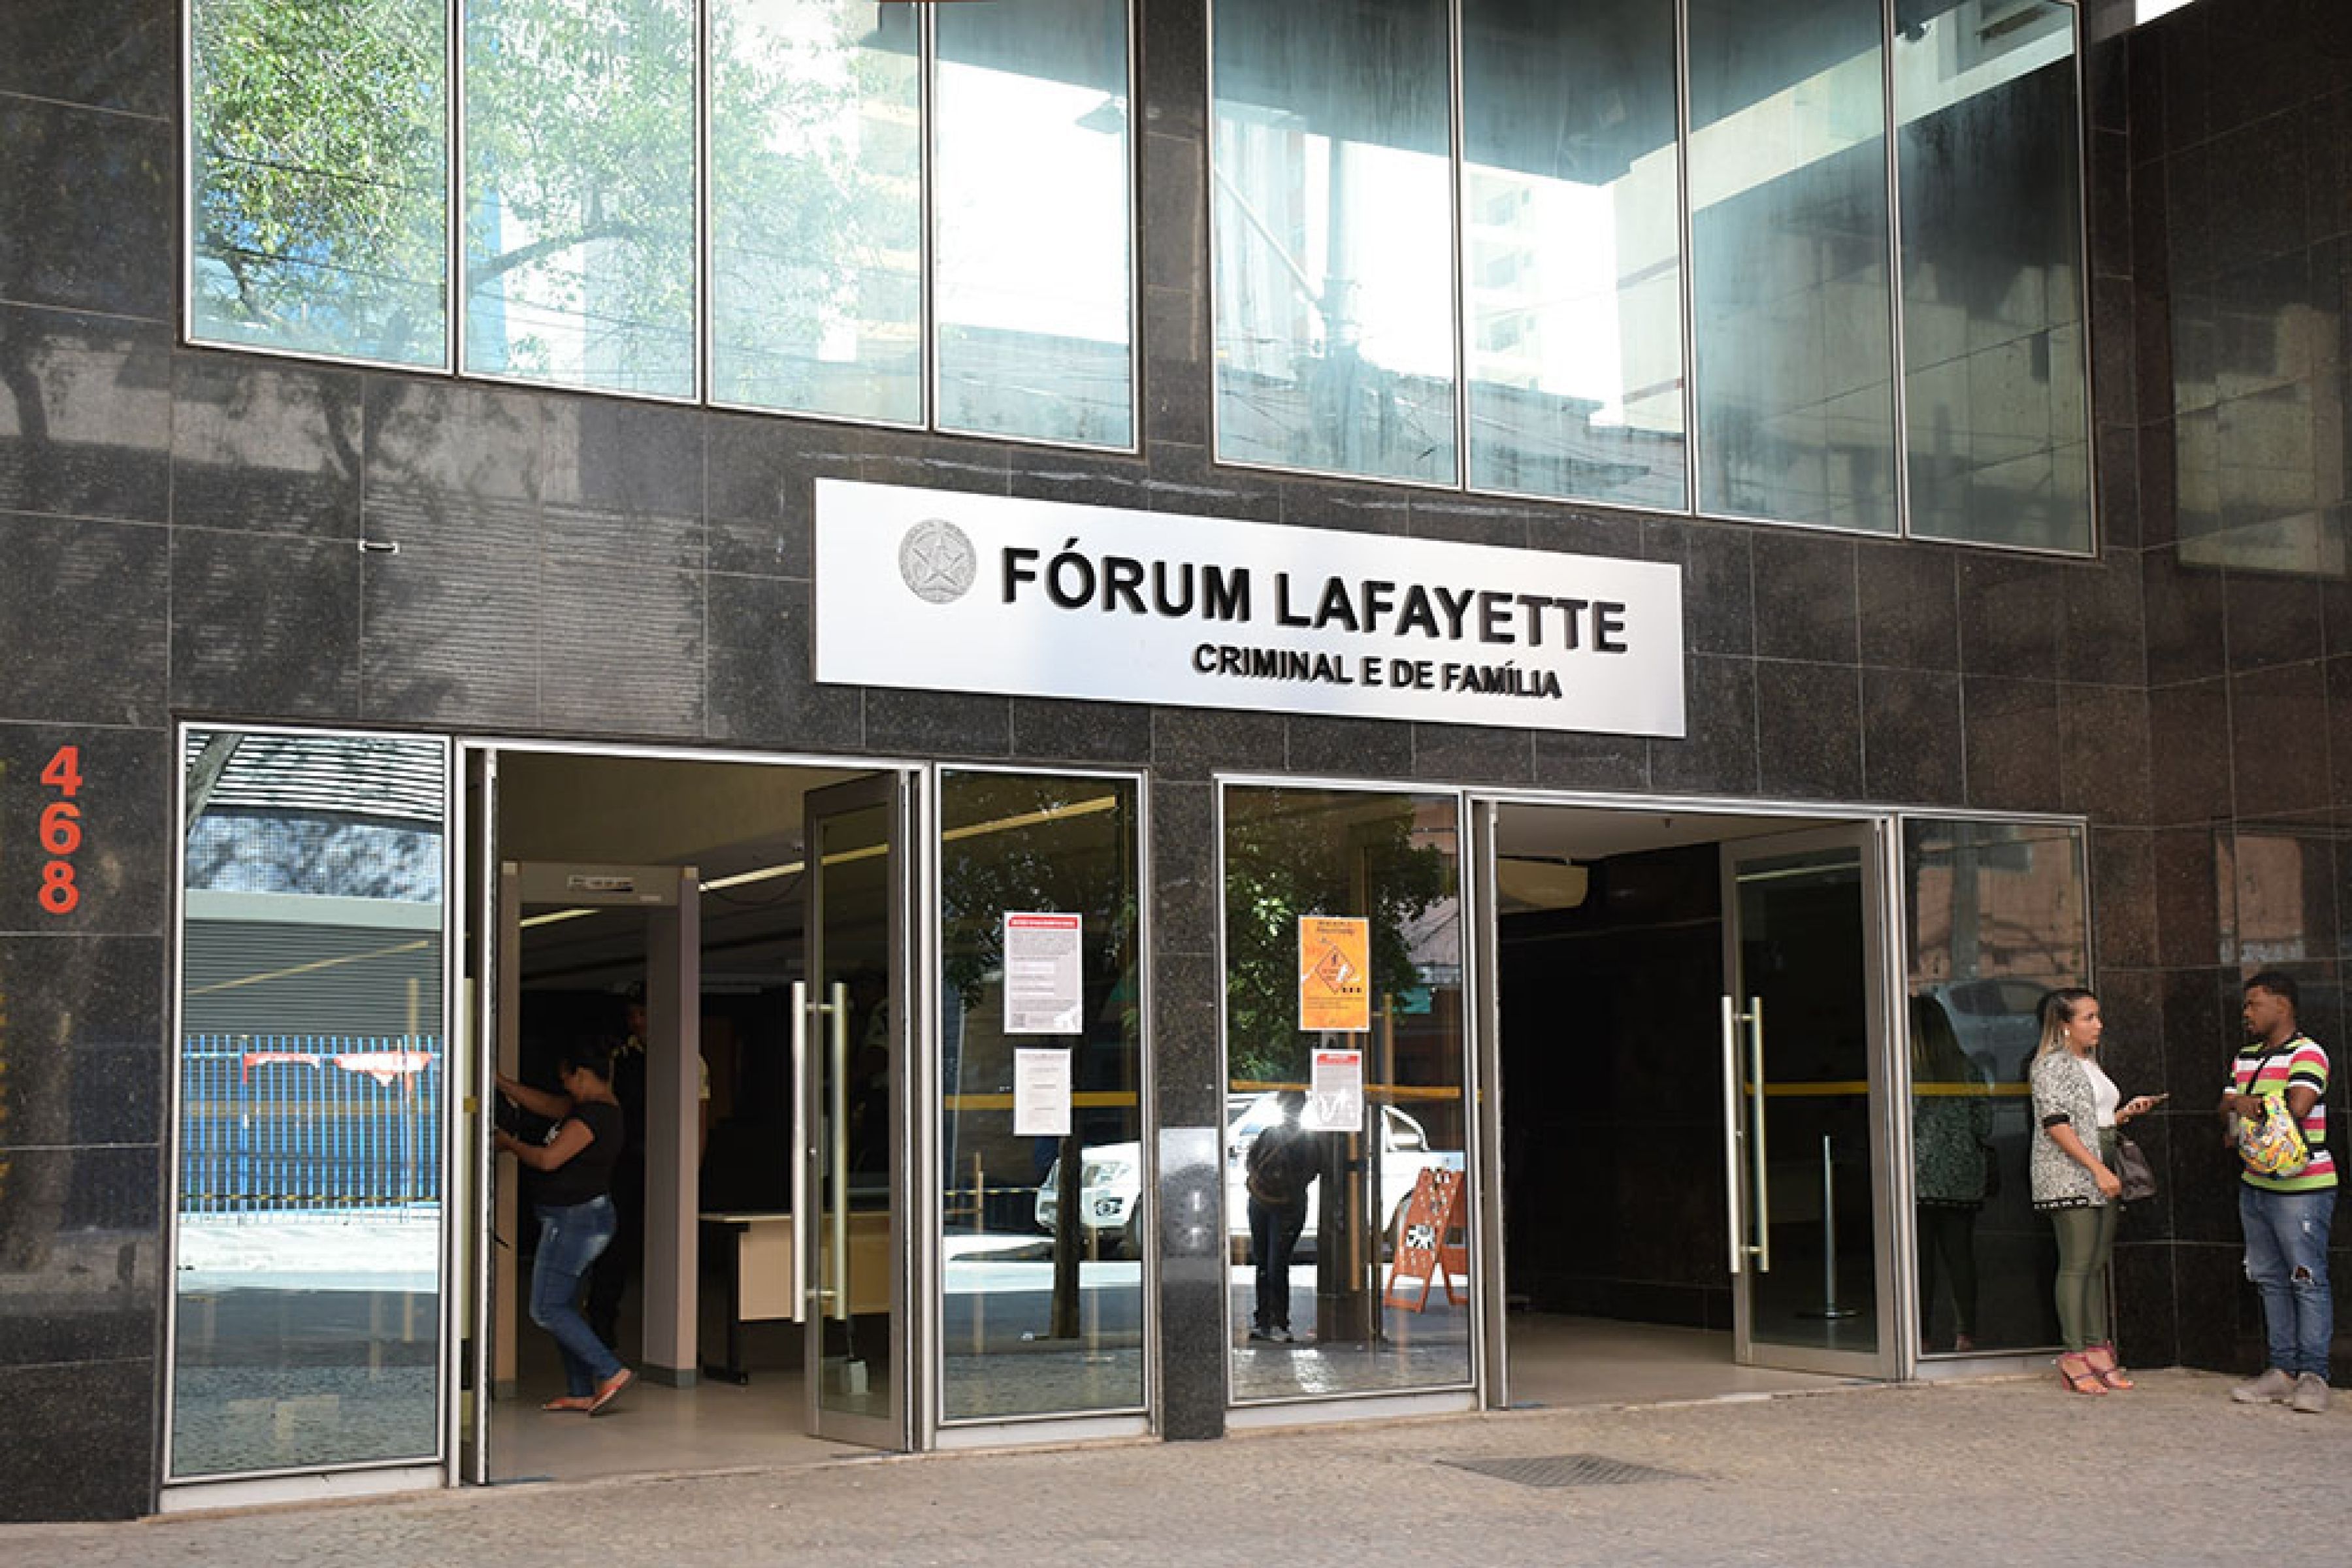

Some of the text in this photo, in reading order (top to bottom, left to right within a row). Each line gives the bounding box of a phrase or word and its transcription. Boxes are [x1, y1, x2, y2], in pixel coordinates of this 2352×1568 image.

[1002, 536, 1627, 653] FÓRUM LAFAYETTE
[1193, 642, 1563, 698] CRIMINAL E DE FAMÍLIA
[38, 745, 83, 915] 468
